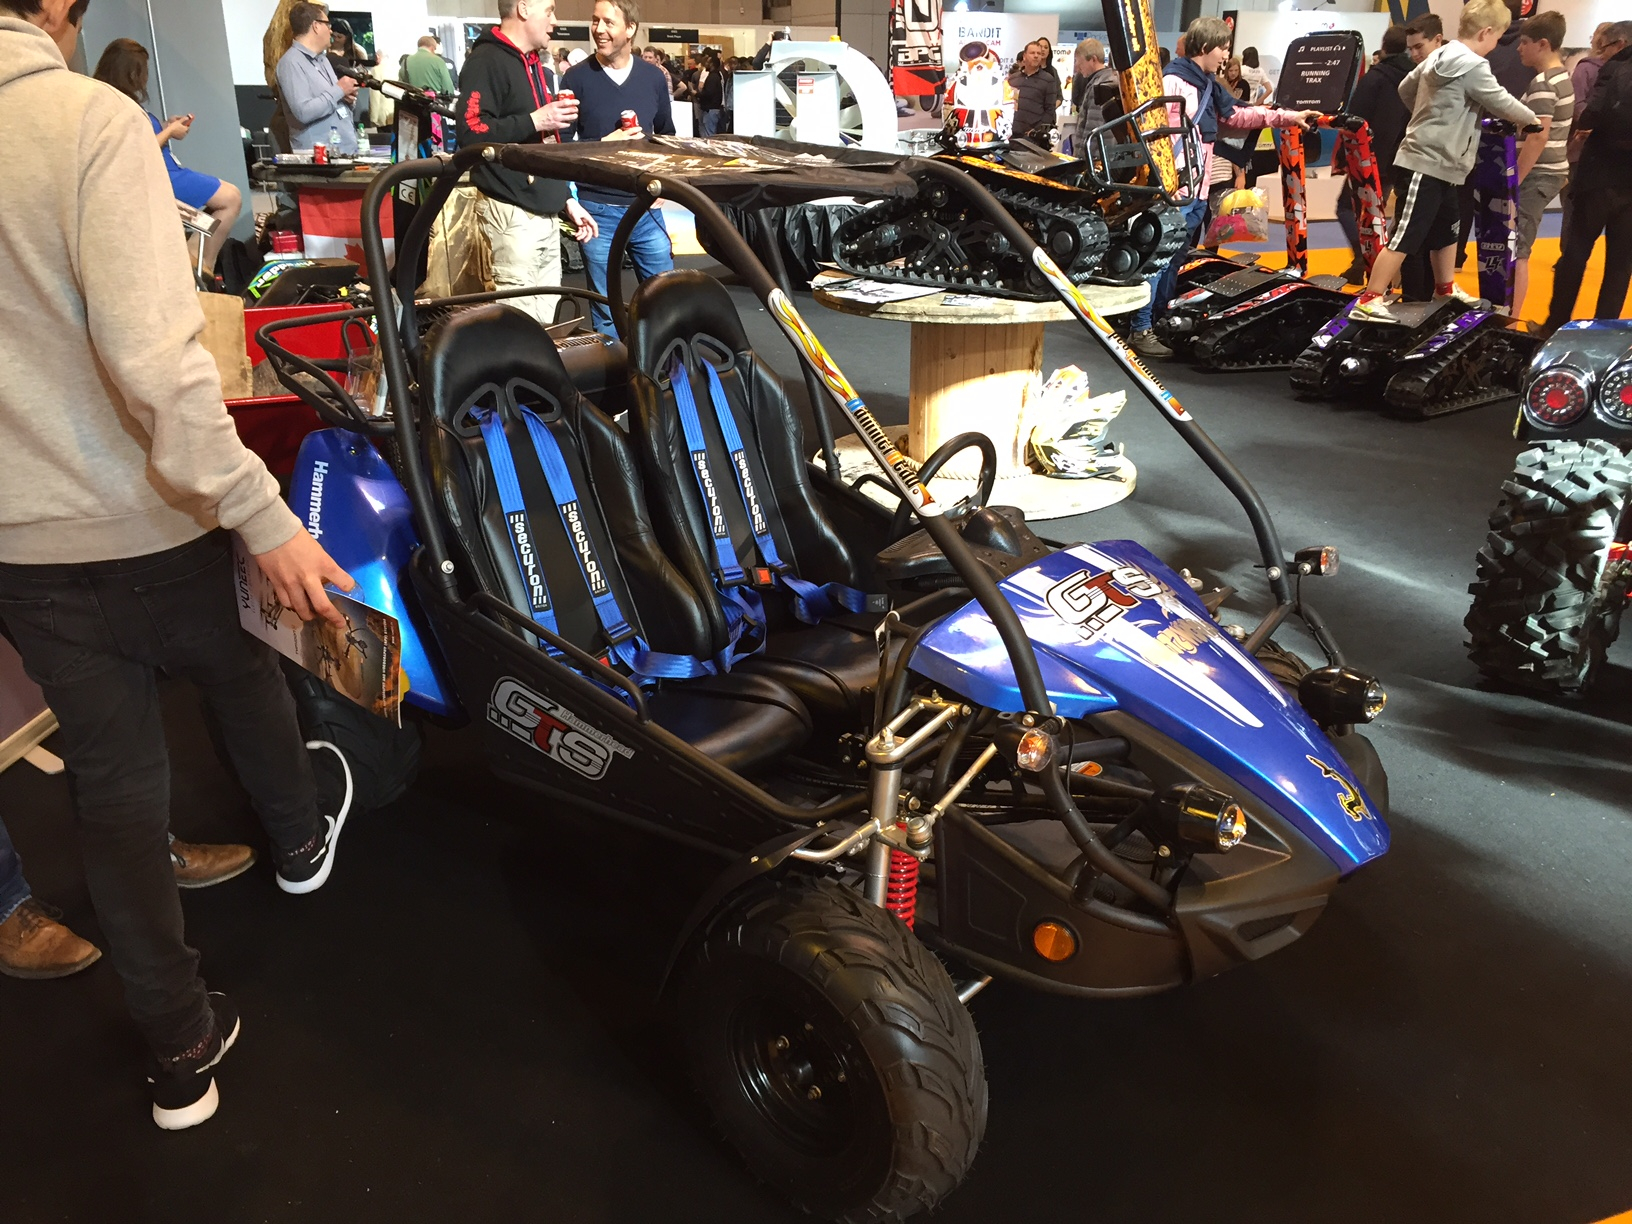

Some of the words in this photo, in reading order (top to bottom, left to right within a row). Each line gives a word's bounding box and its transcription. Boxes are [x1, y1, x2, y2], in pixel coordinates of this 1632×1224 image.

[958, 27, 1002, 38] BANDIT
[308, 460, 329, 541] Hammerh
[697, 460, 722, 526] securon
[739, 458, 763, 525] securon
[514, 522, 543, 597] securon
[568, 511, 601, 583] securon
[1046, 566, 1164, 626] GTS
[494, 680, 610, 776] GTS
[560, 710, 635, 759] Hammerhead
